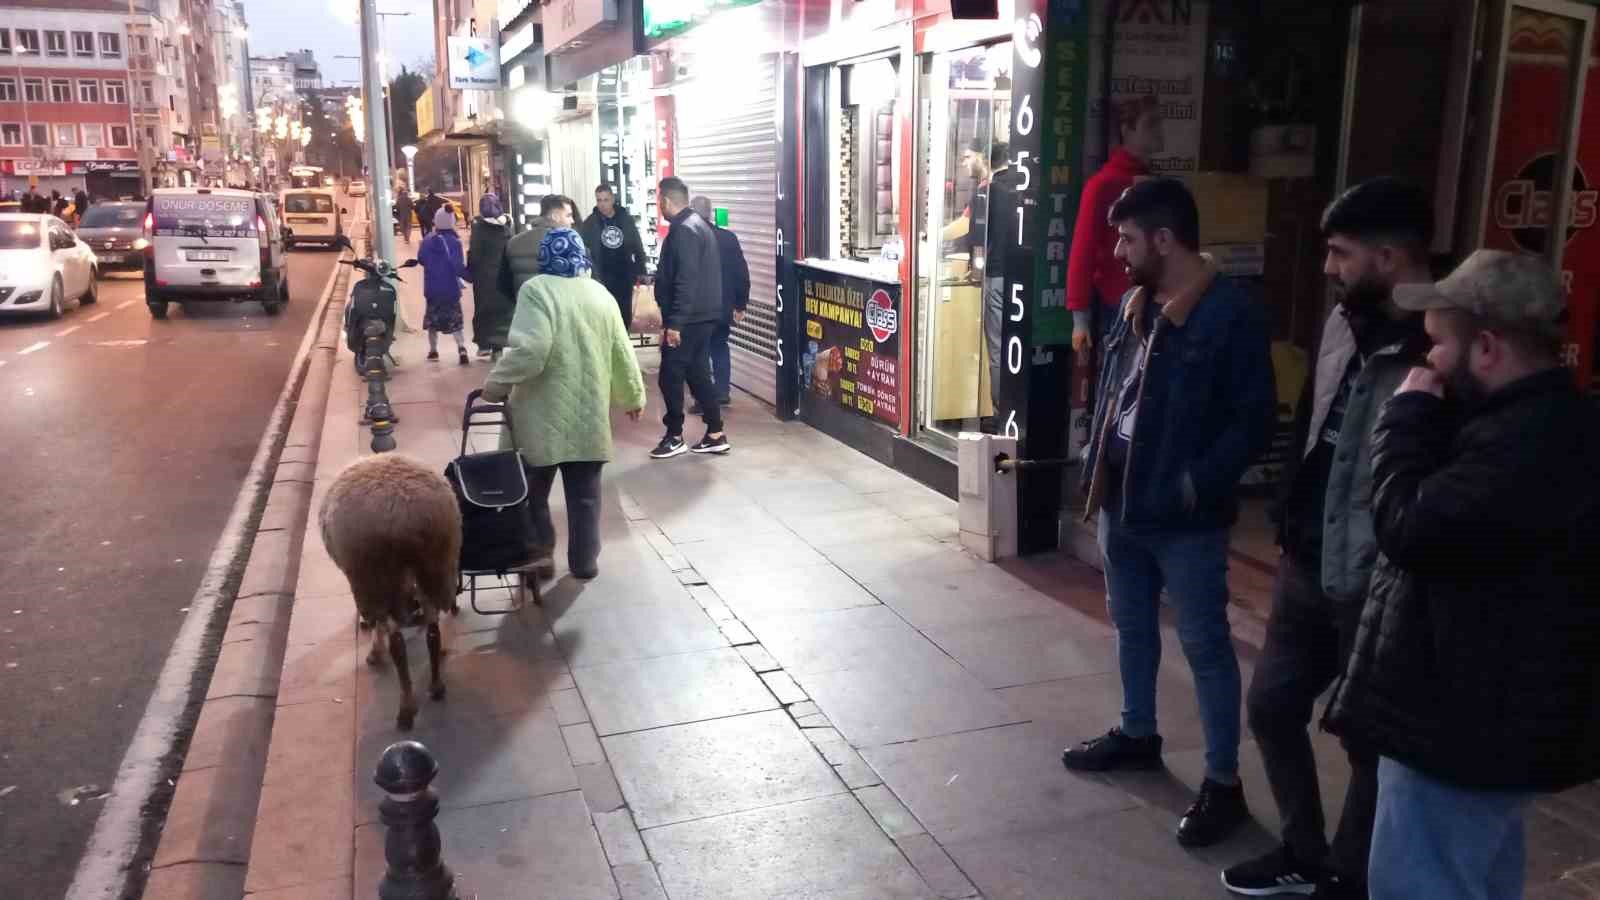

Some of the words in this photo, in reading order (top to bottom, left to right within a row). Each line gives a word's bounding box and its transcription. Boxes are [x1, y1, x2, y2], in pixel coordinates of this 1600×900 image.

[161, 198, 195, 211] ONUR
[1497, 180, 1598, 229] Clas
[805, 296, 819, 315] DEV
